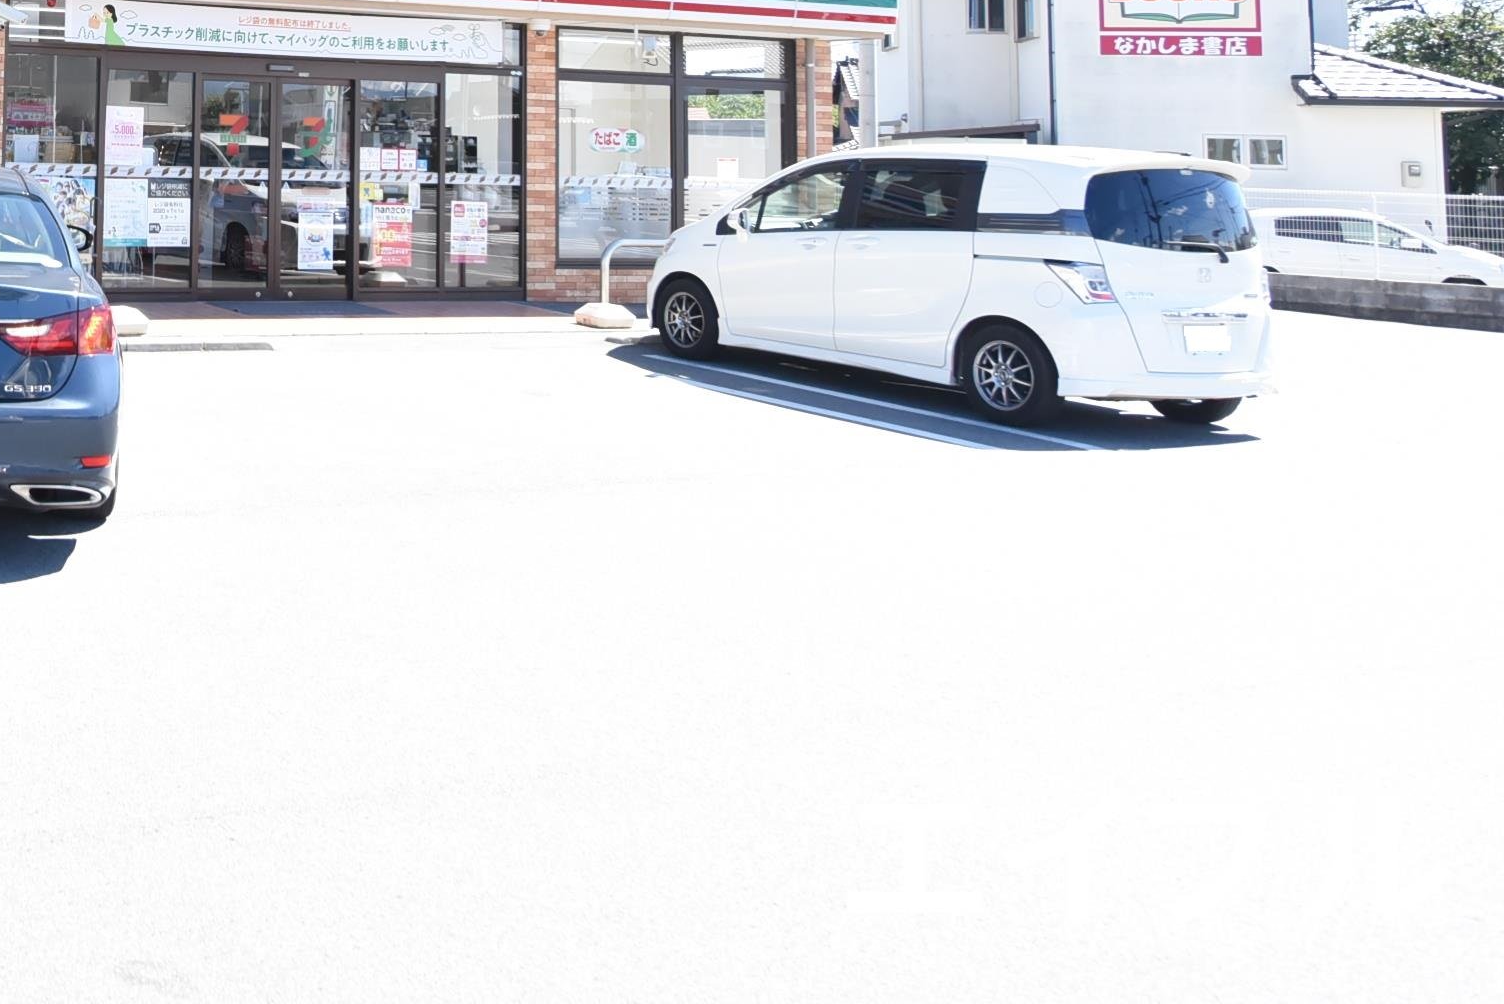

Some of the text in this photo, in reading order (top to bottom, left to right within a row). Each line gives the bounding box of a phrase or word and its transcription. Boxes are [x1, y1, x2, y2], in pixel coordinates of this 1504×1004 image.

[238, 14, 351, 32] レジ袋の無料配布は終了しました。
[125, 23, 454, 53] プラスチック削減に向けて、マイバッグのご利用をお願いします。
[1113, 36, 1248, 55] なかしま書店
[594, 131, 637, 147] たばこ 酒
[4, 384, 24, 393] GS
